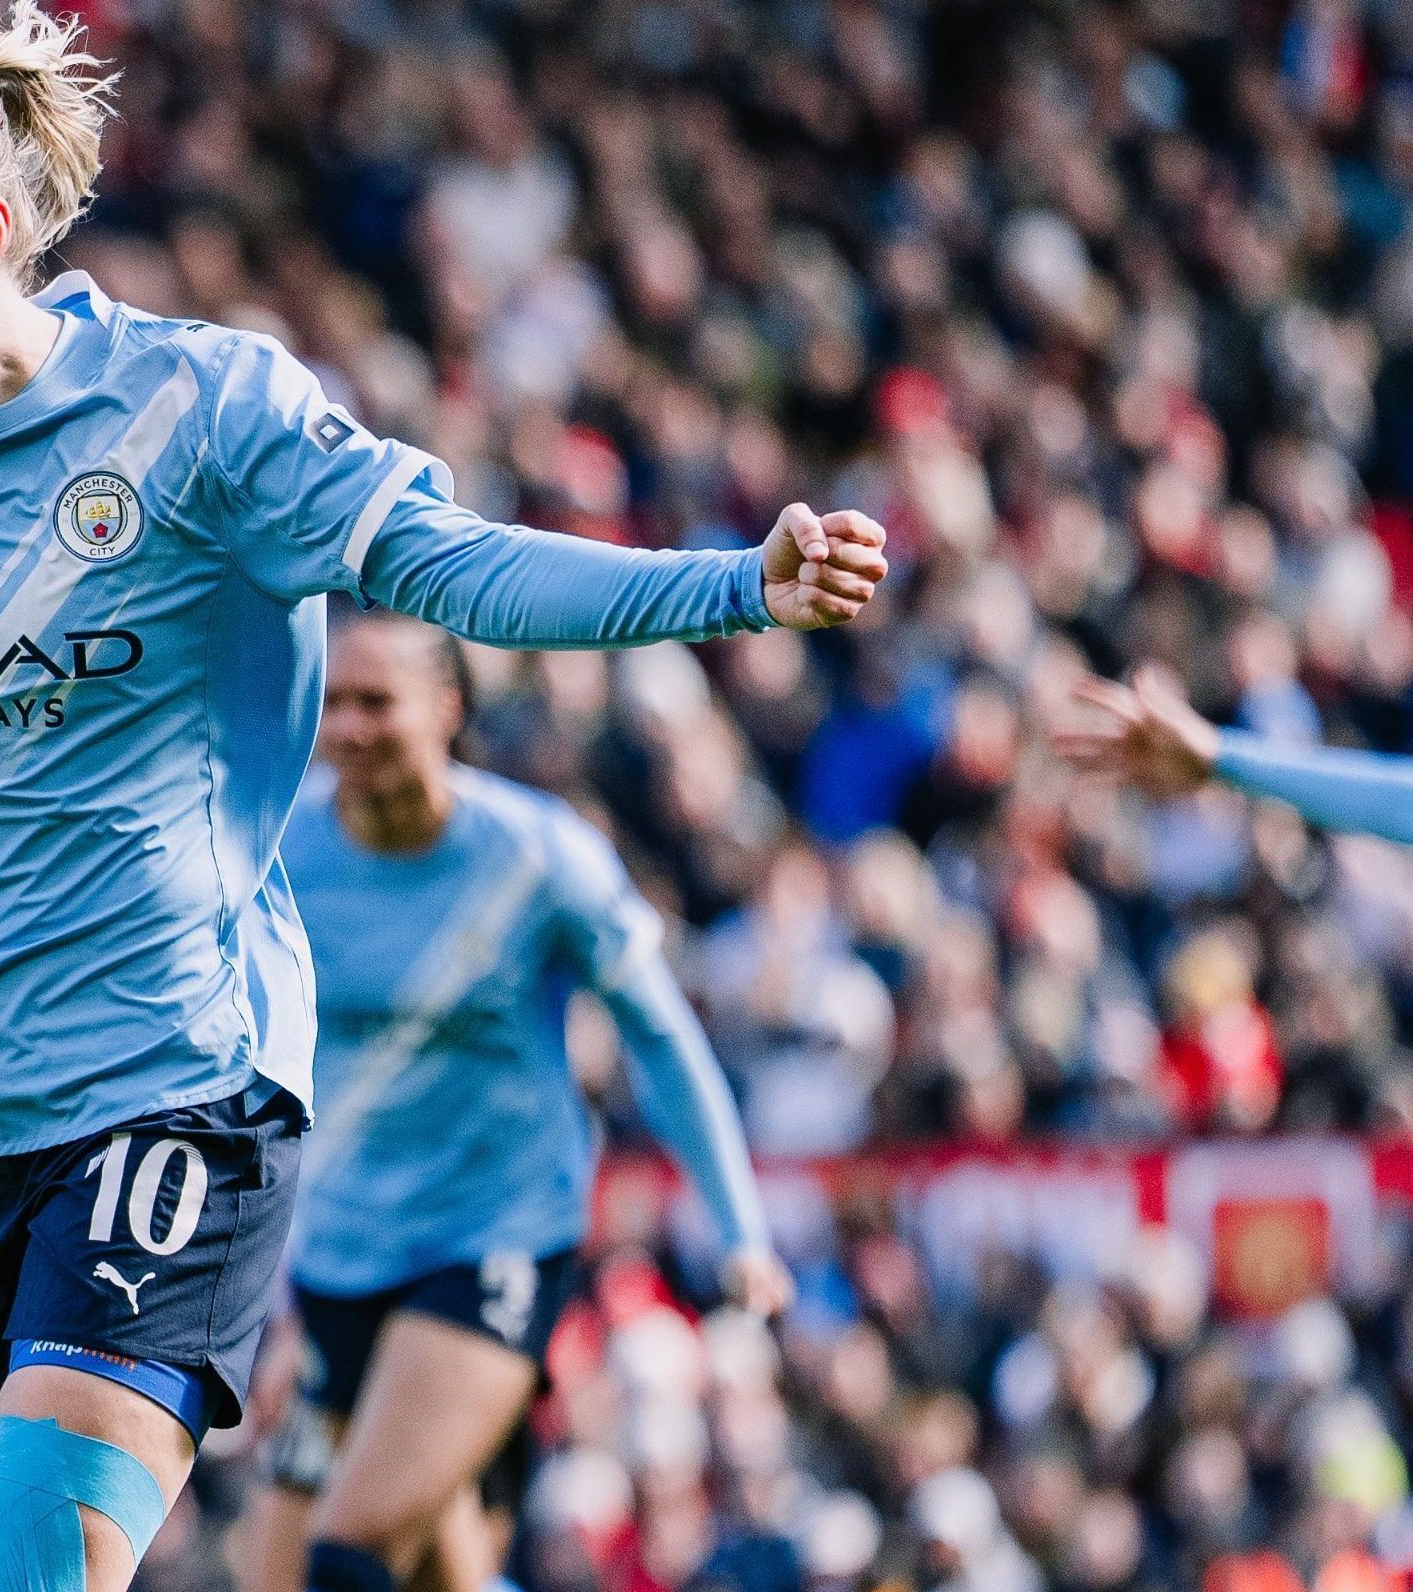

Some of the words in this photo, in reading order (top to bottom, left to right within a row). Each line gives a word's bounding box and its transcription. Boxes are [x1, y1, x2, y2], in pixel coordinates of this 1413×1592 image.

[63, 479, 133, 509] MANCHESTER
[89, 546, 116, 556] CITY
[84, 1131, 208, 1256] 10
